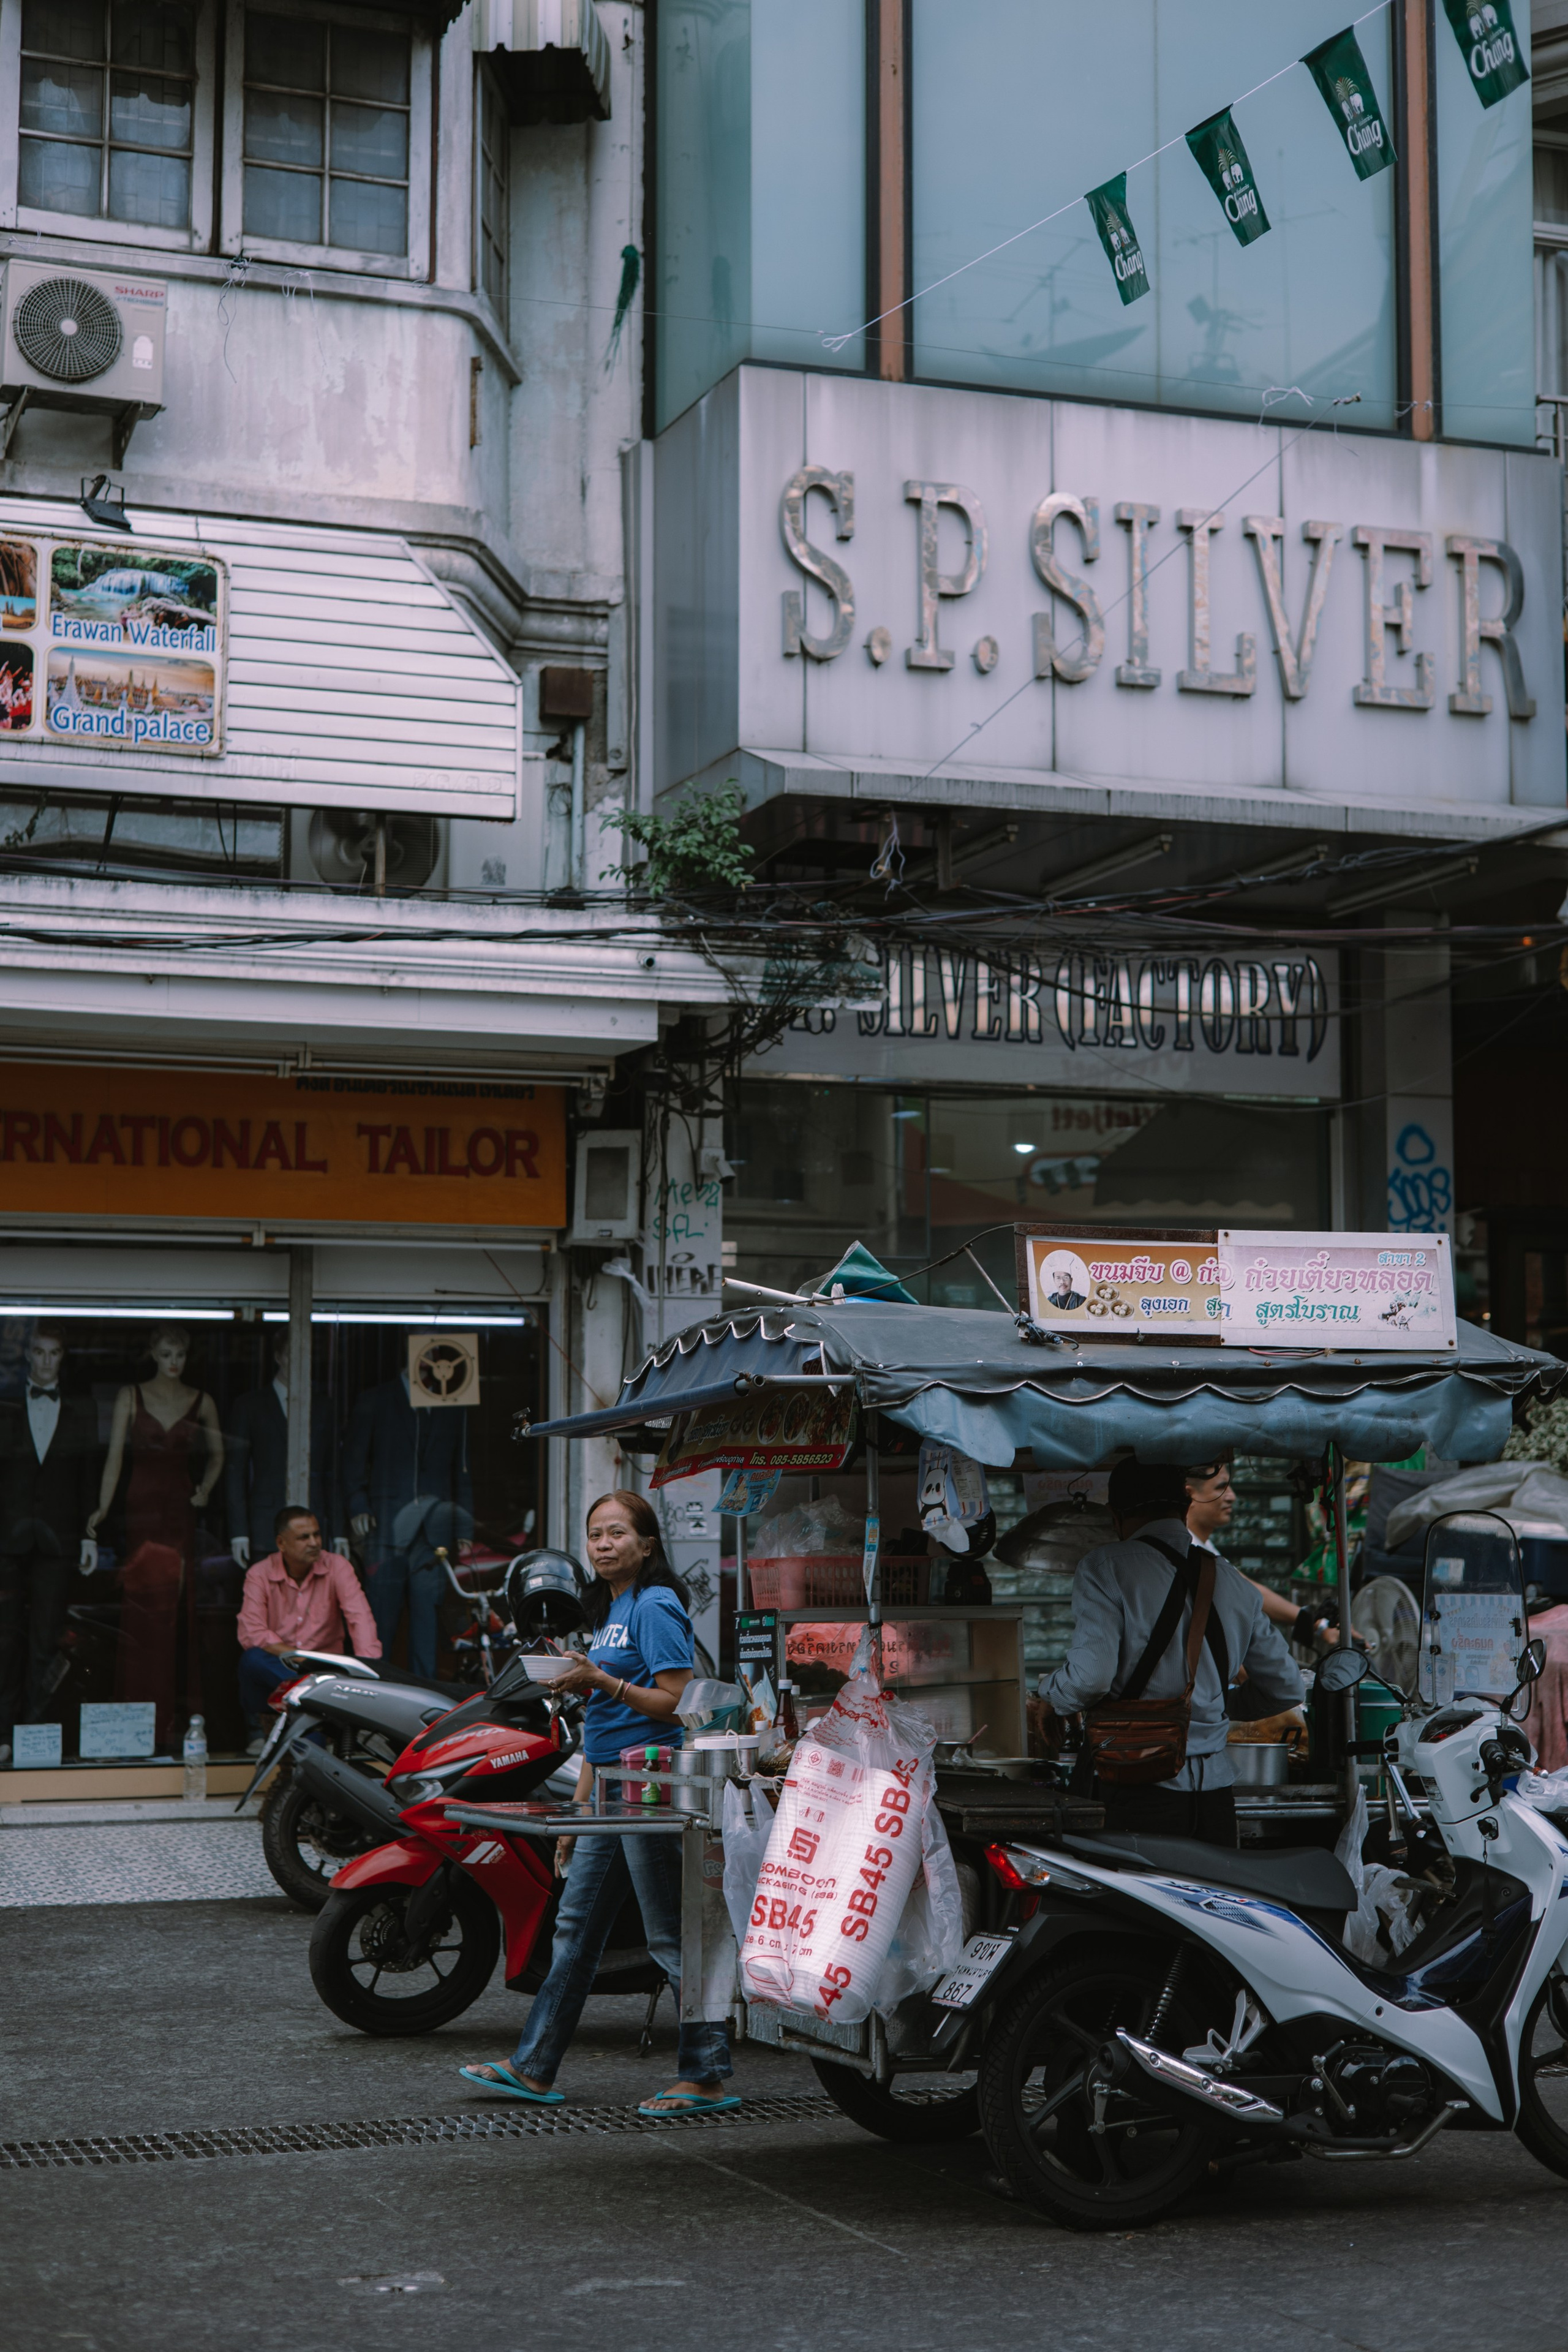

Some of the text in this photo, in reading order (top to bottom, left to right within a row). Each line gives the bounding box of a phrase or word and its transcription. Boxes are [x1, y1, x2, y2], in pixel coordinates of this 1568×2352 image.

[1471, 32, 1515, 80] Chang
[1348, 119, 1384, 156] Chang
[1225, 187, 1258, 224] Chang
[1115, 251, 1144, 282] Chang
[115, 285, 164, 298] SHARP
[1030, 491, 1536, 722] SILVER
[52, 614, 216, 652] Erawan Waterfall
[53, 706, 209, 744] Grand palace
[1054, 949, 1328, 1062] (FACTORY)
[0, 1110, 540, 1178] RNATIONAL TAILOR
[1090, 1256, 1164, 1283] ขนมจีบ
[1170, 1259, 1192, 1284] @
[1245, 1253, 1434, 1291] ก๋วยเตี๋ยวหลอด
[1378, 1252, 1426, 1265] สาขา 2
[1140, 1297, 1189, 1317] ลุงเอก
[1255, 1296, 1359, 1327] สูตรโบราณ
[770, 1453, 832, 1464] 085-5856523
[490, 1749, 529, 1770] YAMAHA
[875, 1757, 920, 1838] SB45
[840, 1844, 893, 1942] SB45
[750, 1894, 817, 1938] SB45
[758, 1934, 764, 1945] 6
[799, 1948, 812, 1959] cm
[943, 1981, 973, 2002] 867
